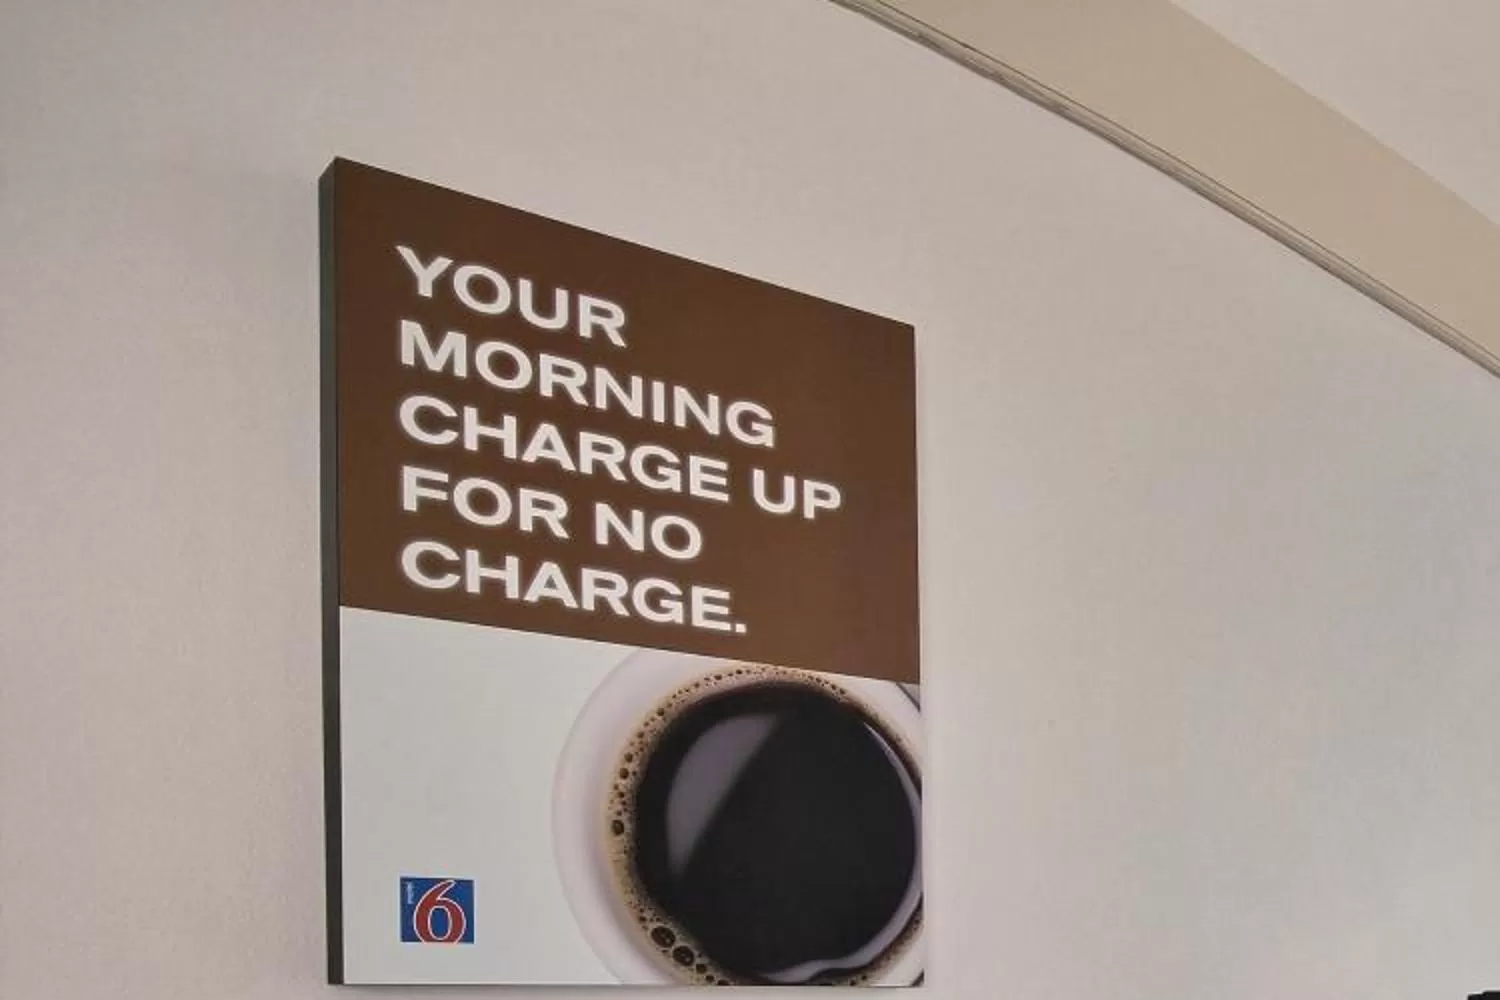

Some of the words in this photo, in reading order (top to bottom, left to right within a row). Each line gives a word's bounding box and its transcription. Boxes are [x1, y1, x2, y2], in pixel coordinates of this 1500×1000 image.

[395, 245, 627, 348] YOUR
[400, 319, 775, 449] MORNING
[399, 395, 730, 503] CHARGE
[752, 467, 842, 520] UP
[402, 465, 570, 539] FOR
[595, 501, 703, 560] NO
[401, 540, 747, 634] CHARGE.
[413, 879, 467, 944] 6
